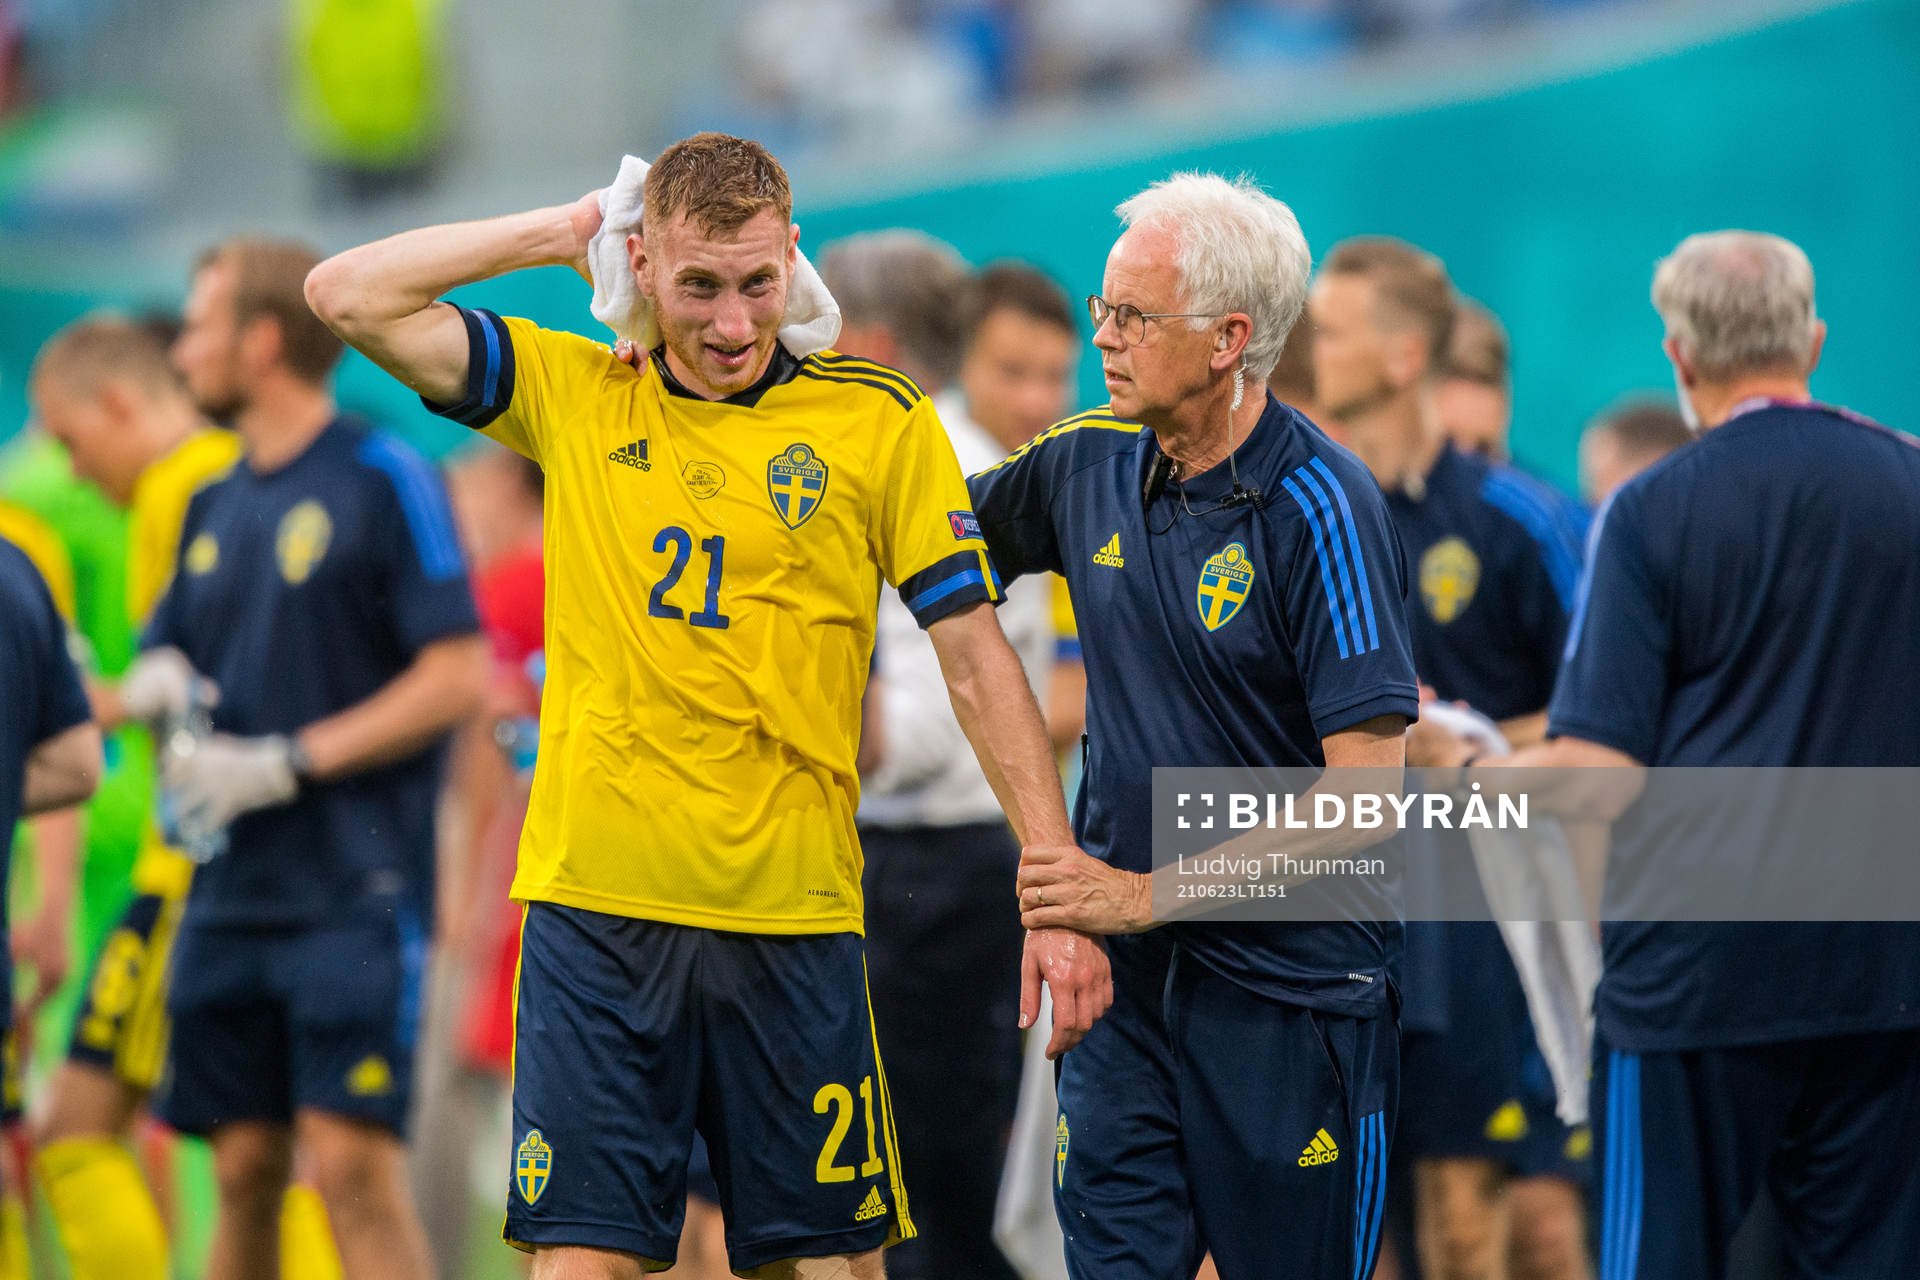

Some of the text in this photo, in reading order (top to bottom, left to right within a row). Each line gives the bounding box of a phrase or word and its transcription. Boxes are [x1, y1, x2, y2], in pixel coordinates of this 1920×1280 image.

[608, 451, 652, 472] adidas
[778, 466, 818, 477] SVERIGE
[1093, 553, 1125, 569] adidas
[648, 526, 730, 629] 21
[1210, 565, 1246, 580] SVERIGE
[813, 1075, 884, 1183] 21
[855, 1202, 888, 1221] adidas
